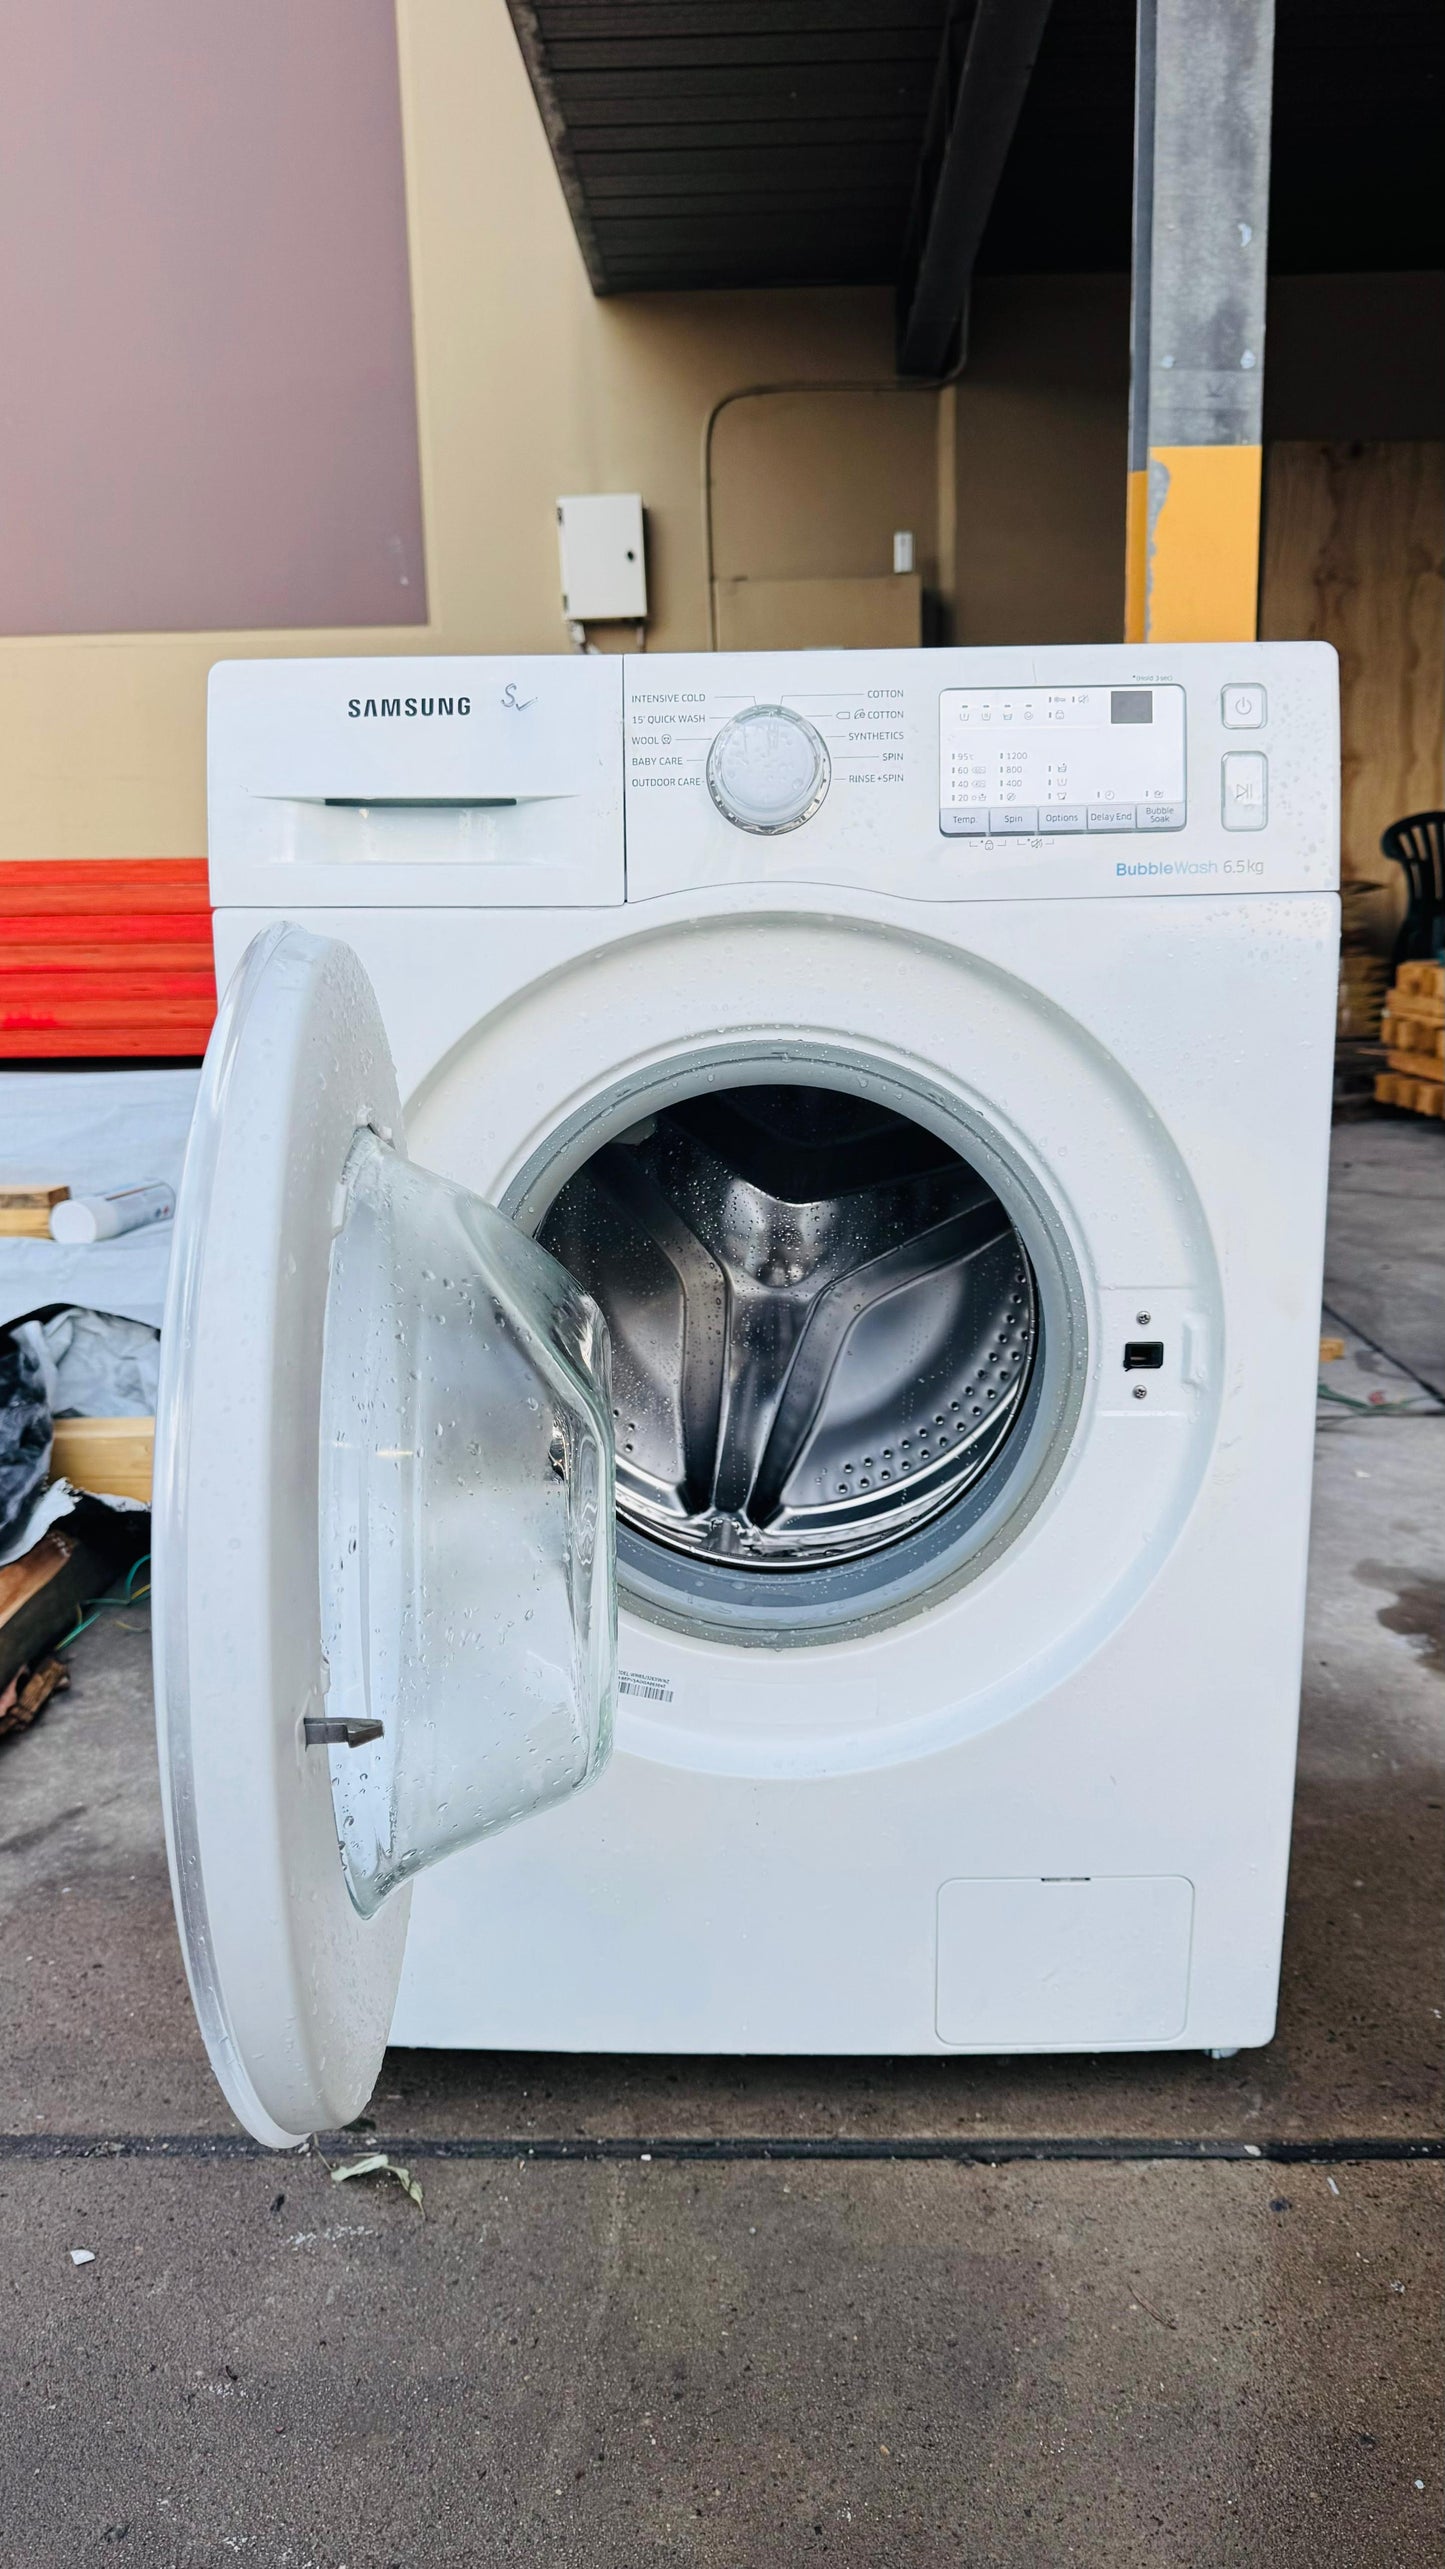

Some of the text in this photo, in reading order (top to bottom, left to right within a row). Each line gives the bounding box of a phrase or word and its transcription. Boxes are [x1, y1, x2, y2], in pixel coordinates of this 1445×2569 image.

[632, 693, 706, 702] INTENSIVE COLD
[867, 689, 904, 698] COTTON
[348, 697, 471, 718] SAMSUNG
[647, 714, 677, 724] QUICK
[678, 714, 706, 723] WASH
[867, 710, 904, 719] COTTON
[631, 736, 660, 745] WOOL
[848, 731, 904, 741] SYNTHETICS
[882, 752, 904, 761] SPIN
[1006, 751, 1028, 760] 1200
[632, 756, 684, 766] BABY CARE
[957, 767, 969, 775] 60
[1006, 765, 1023, 774] 800
[631, 777, 701, 787] OUTDOOR CARE
[957, 780, 969, 789] 40
[1006, 779, 1023, 788] 400
[957, 794, 969, 802] 20
[1145, 807, 1175, 815] Bubble
[1004, 814, 1024, 824] Spin
[1045, 814, 1079, 823] Options
[1090, 812, 1133, 822] Delay End
[1150, 815, 1170, 824] Soak
